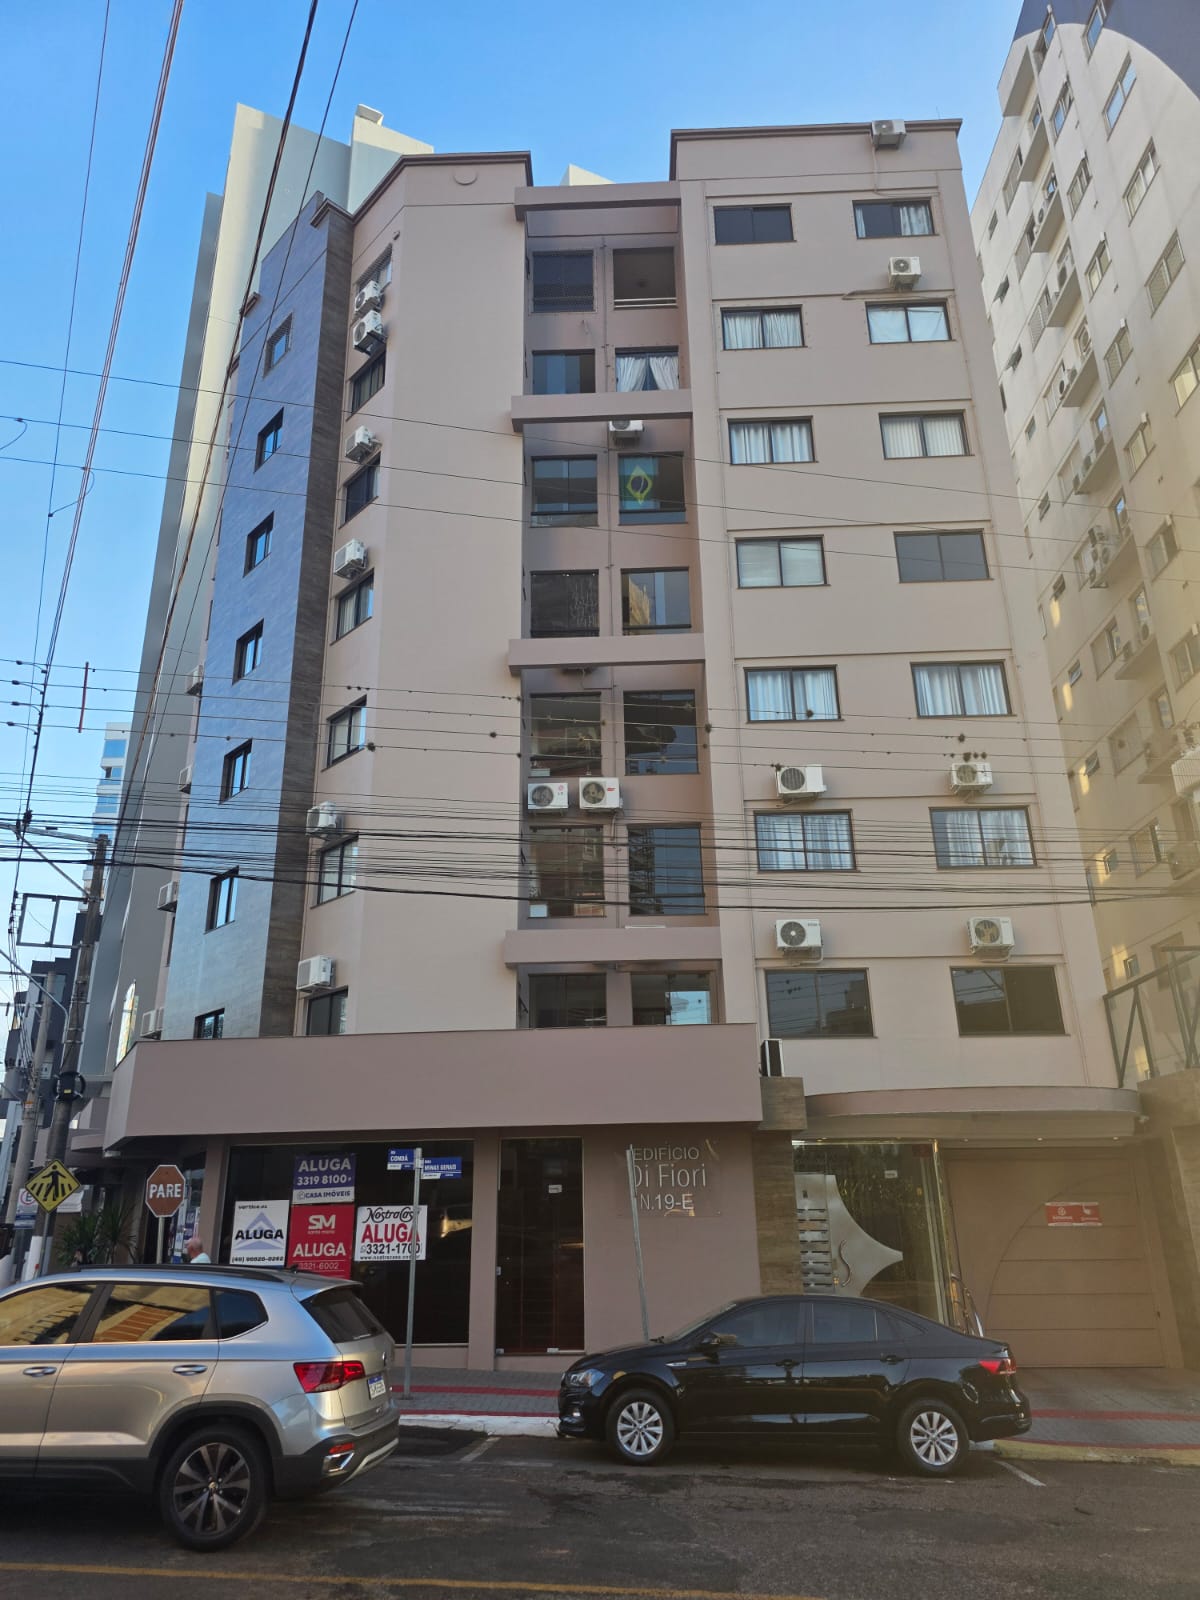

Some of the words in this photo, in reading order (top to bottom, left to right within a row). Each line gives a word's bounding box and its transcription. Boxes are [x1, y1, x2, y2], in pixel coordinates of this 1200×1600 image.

[298, 1158, 352, 1172] ALUGA
[297, 1175, 320, 1186] 3319
[321, 1174, 348, 1185] 8100
[658, 1163, 706, 1188] Fiori
[150, 1183, 182, 1198] PARE
[640, 1193, 695, 1210] N.19-E
[308, 1214, 336, 1230] SM
[235, 1229, 284, 1240] ALUGA
[361, 1223, 420, 1243] ALUGA
[292, 1242, 347, 1258] ALUGA
